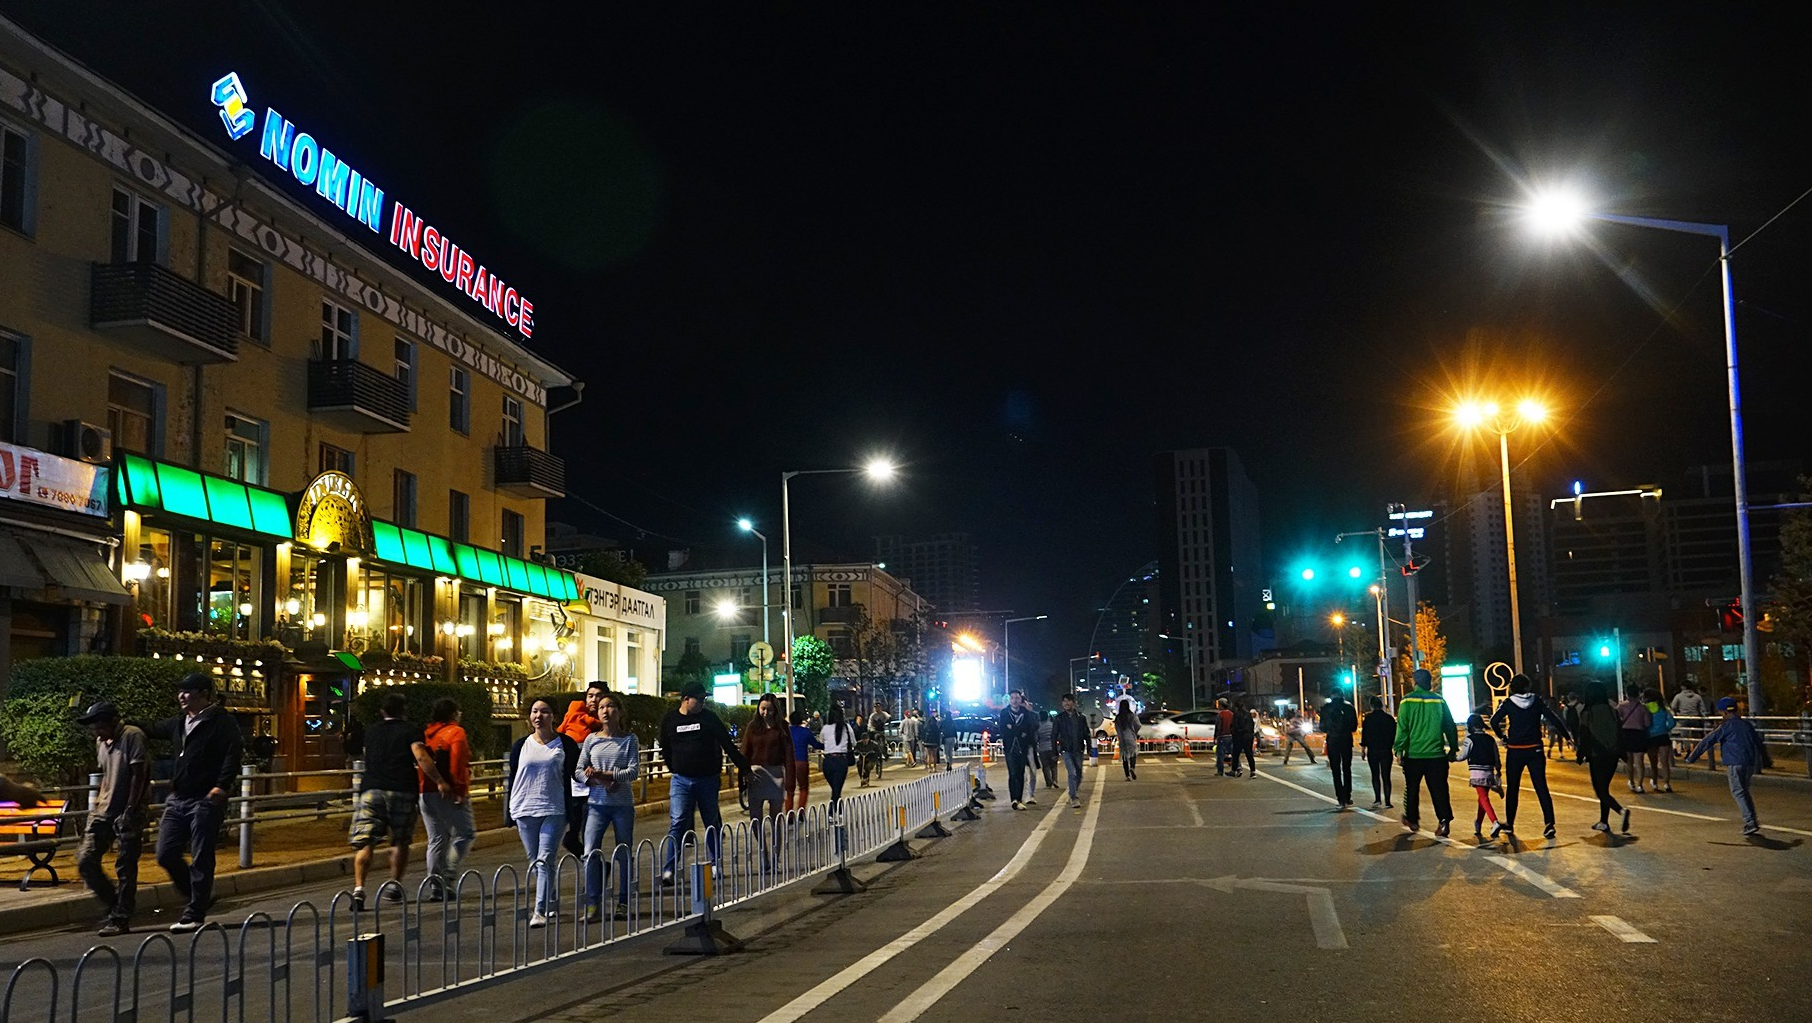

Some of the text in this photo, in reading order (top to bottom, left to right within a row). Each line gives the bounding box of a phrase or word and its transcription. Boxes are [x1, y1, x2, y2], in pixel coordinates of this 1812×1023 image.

[260, 107, 534, 339] NOMIN INSURANCE
[587, 587, 655, 619] ТЭНГЭР ДААТГАЛ
